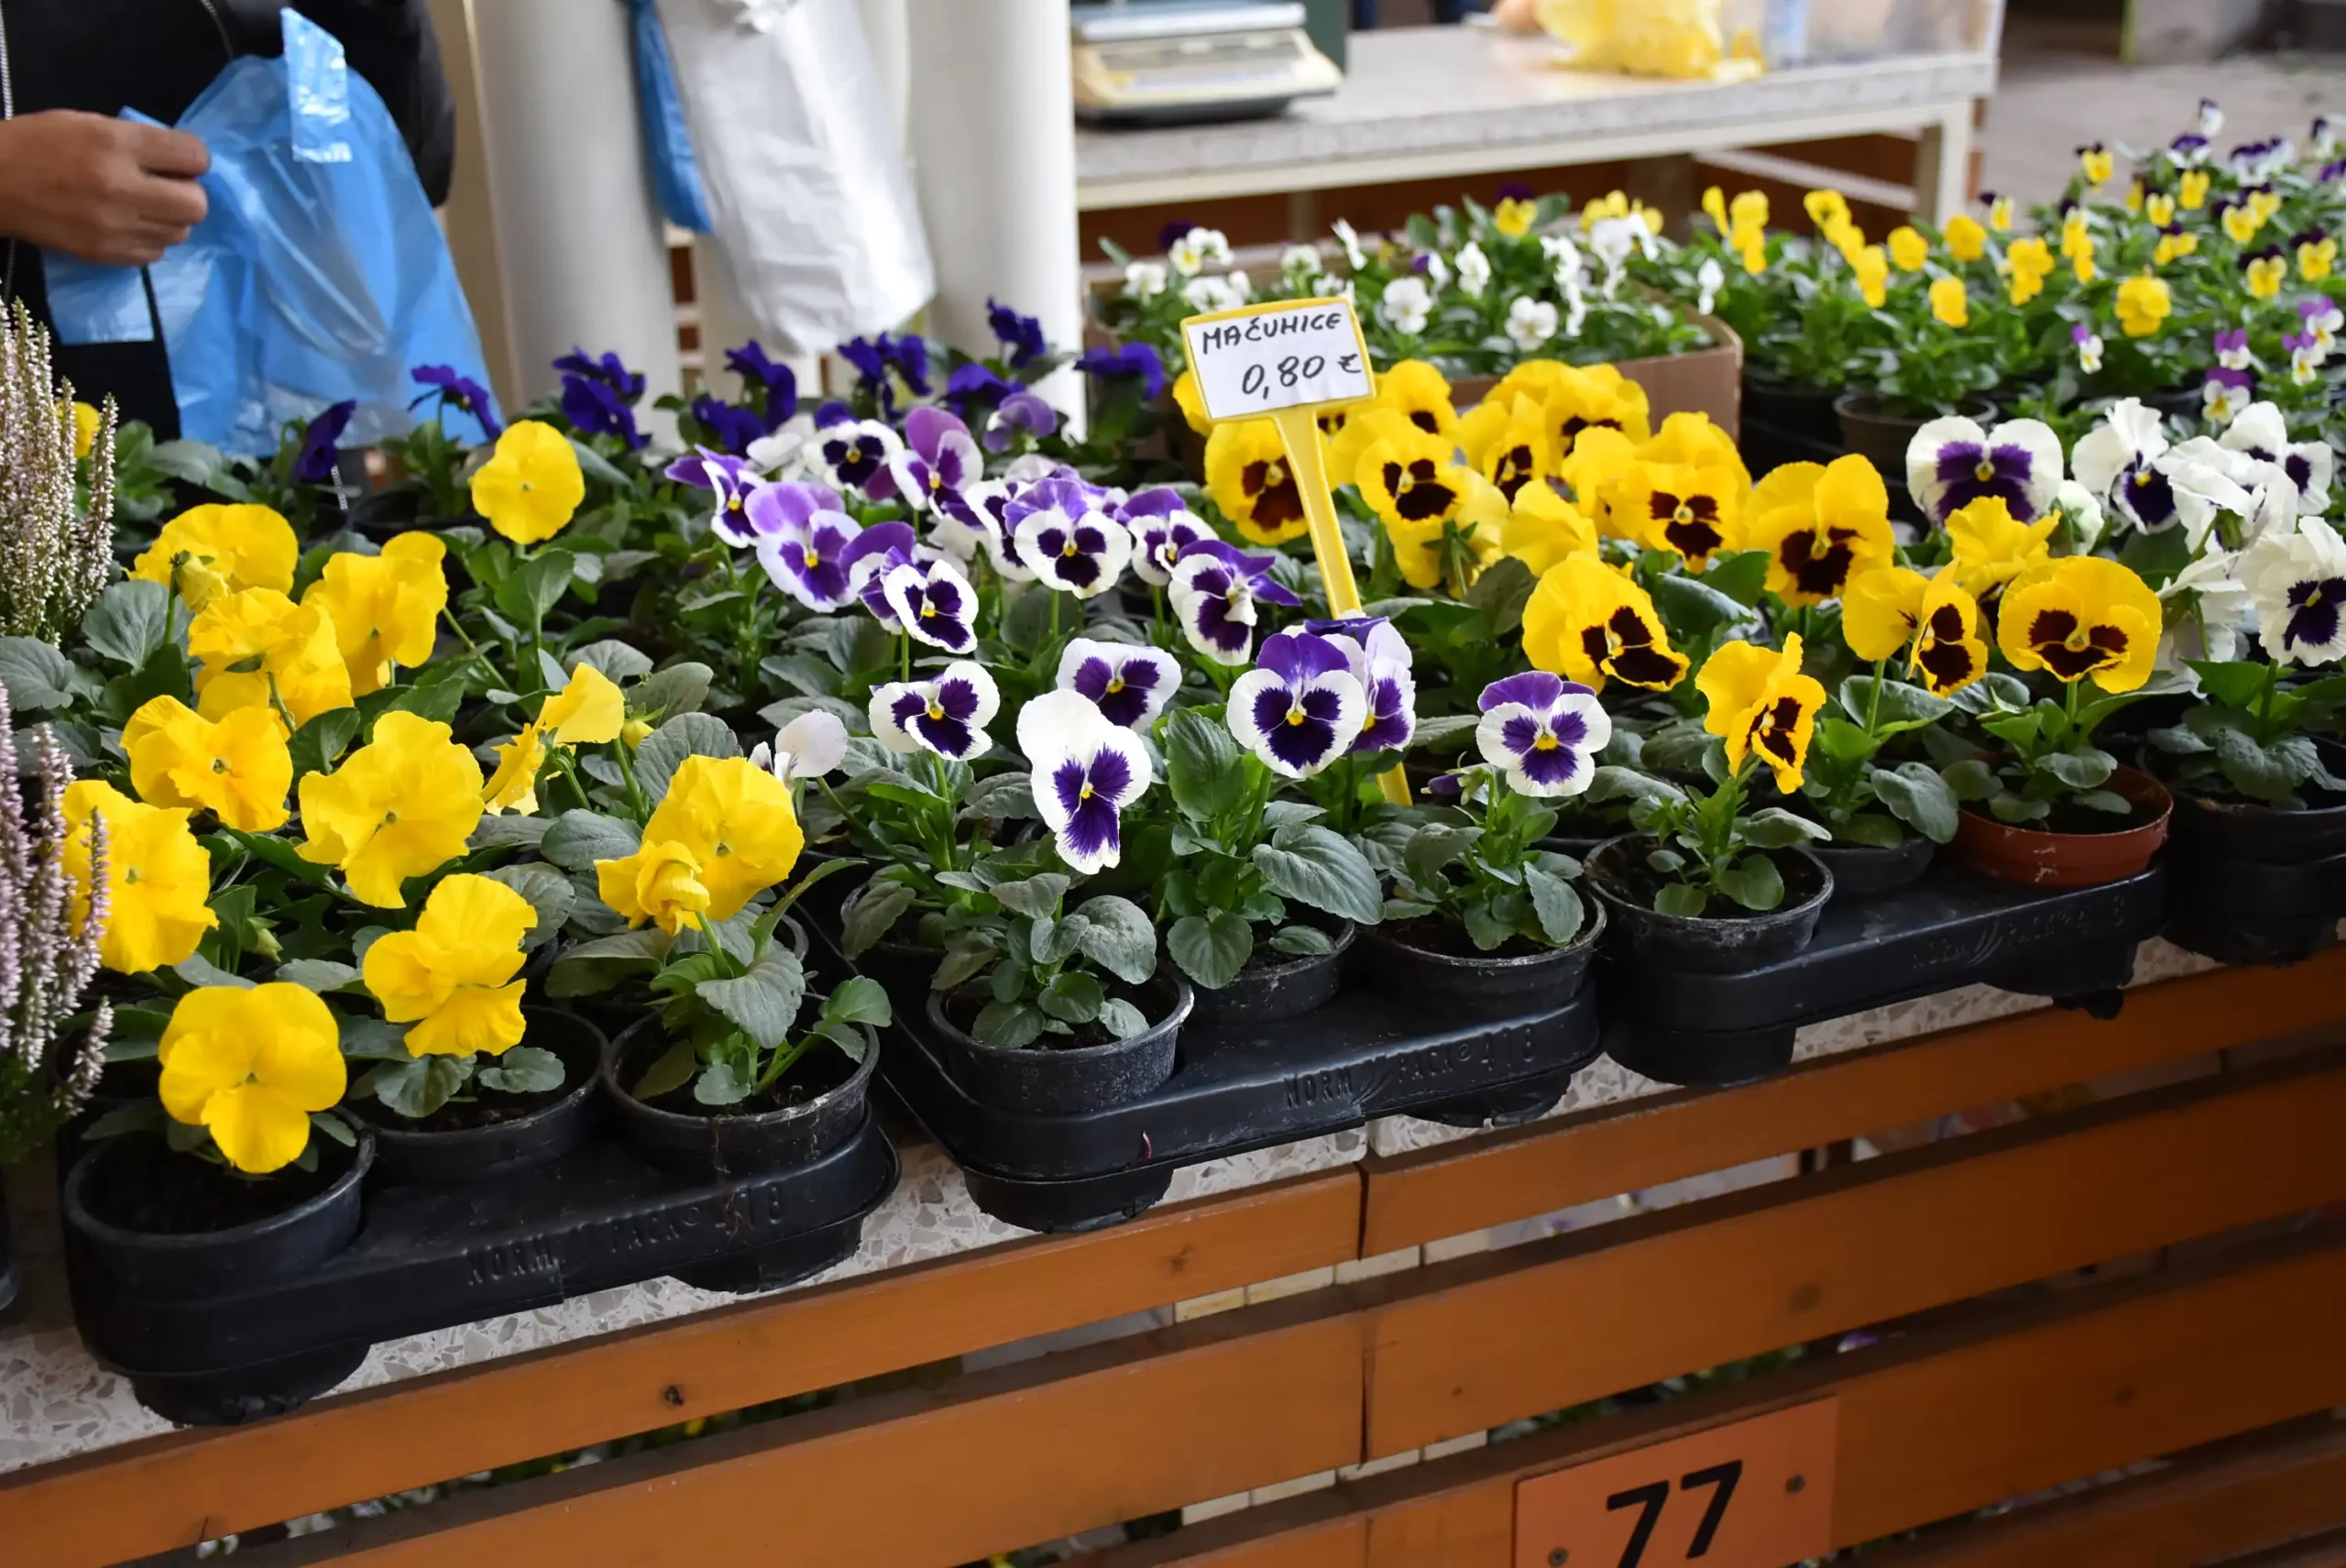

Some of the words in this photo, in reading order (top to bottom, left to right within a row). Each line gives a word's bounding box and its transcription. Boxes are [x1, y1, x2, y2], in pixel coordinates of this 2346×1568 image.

[1242, 356, 1325, 400] 0,80
[1284, 1066, 1354, 1110] NORM
[1606, 1459, 1743, 1568] 77
